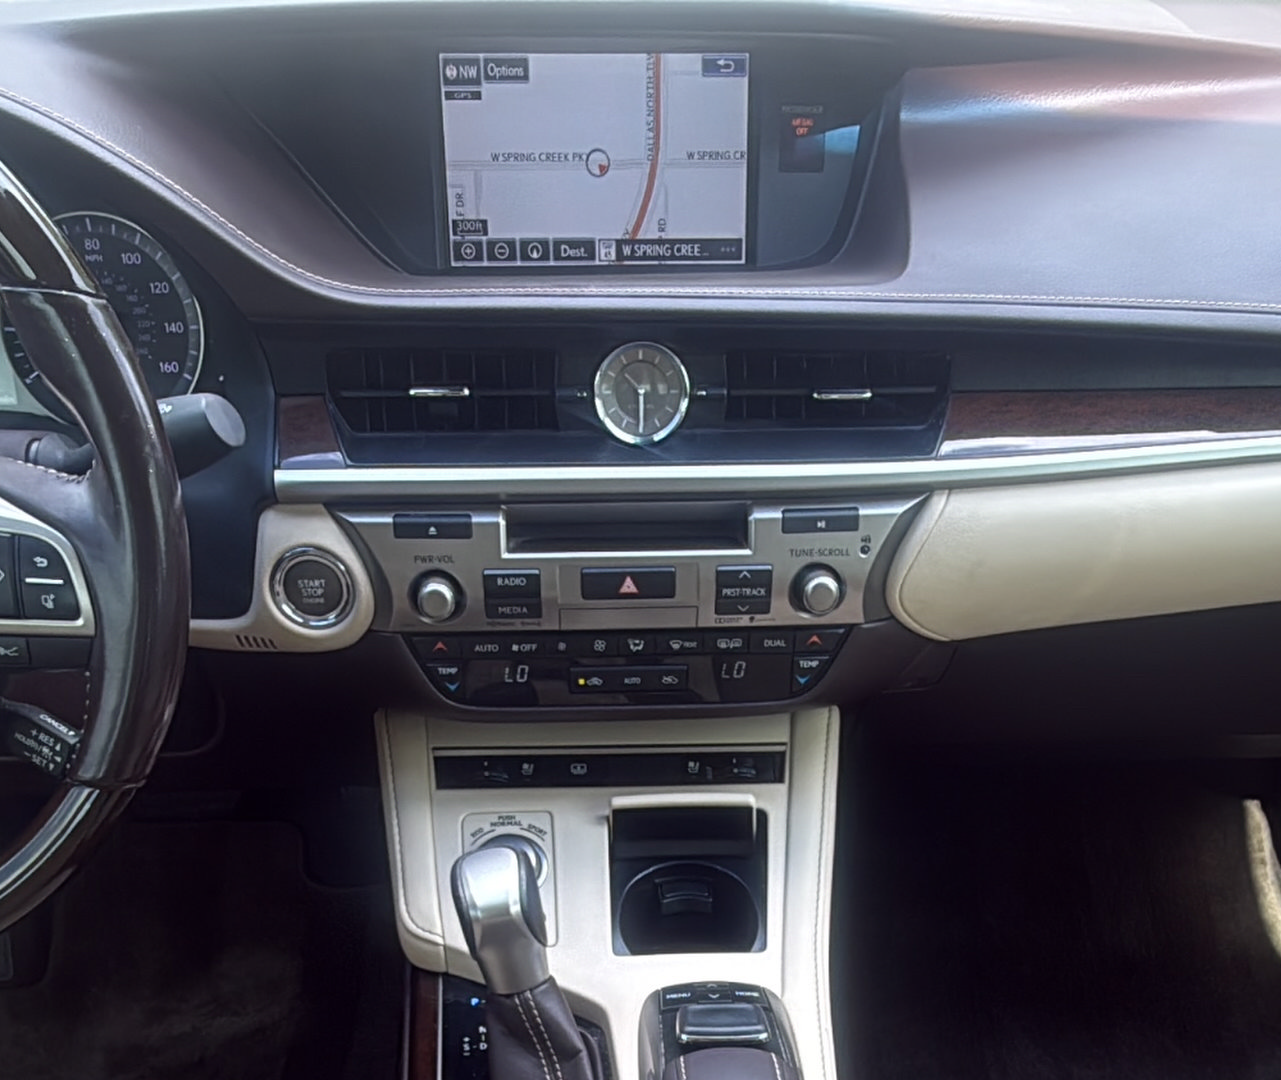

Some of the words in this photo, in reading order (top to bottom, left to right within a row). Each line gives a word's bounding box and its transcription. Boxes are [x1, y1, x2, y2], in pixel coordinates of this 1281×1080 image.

[460, 65, 478, 79] NW
[487, 63, 524, 79] Options
[646, 78, 656, 117] NORTH
[646, 118, 656, 162] DALLAS
[490, 152, 500, 162] W
[501, 152, 536, 162] SPRING
[538, 152, 570, 162] CREEK
[686, 151, 695, 160] W
[696, 150, 721, 160] SPRING
[658, 218, 666, 232] RD
[84, 238, 100, 250] 80
[561, 244, 588, 258] Dest.
[622, 244, 632, 256] W
[634, 244, 671, 257] SPRING
[85, 254, 103, 262] MPH
[122, 252, 142, 265] 100
[150, 282, 170, 294] 120
[164, 322, 184, 334] 140
[160, 362, 180, 374] 160
[298, 579, 326, 588] START
[496, 576, 527, 586] RADIO
[302, 588, 324, 597] STOP
[498, 606, 528, 614] MEDIA
[474, 644, 500, 652] AUTO
[520, 643, 538, 652] OFF
[764, 640, 786, 648] DUAL
[722, 661, 746, 678] LO
[799, 660, 820, 668] TEMP
[505, 665, 529, 682] LO
[624, 677, 641, 685] AUTO
[40, 713, 69, 734] CANCEL
[38, 732, 55, 746] RES
[528, 824, 548, 836] SPORT
[470, 997, 480, 1006] P
